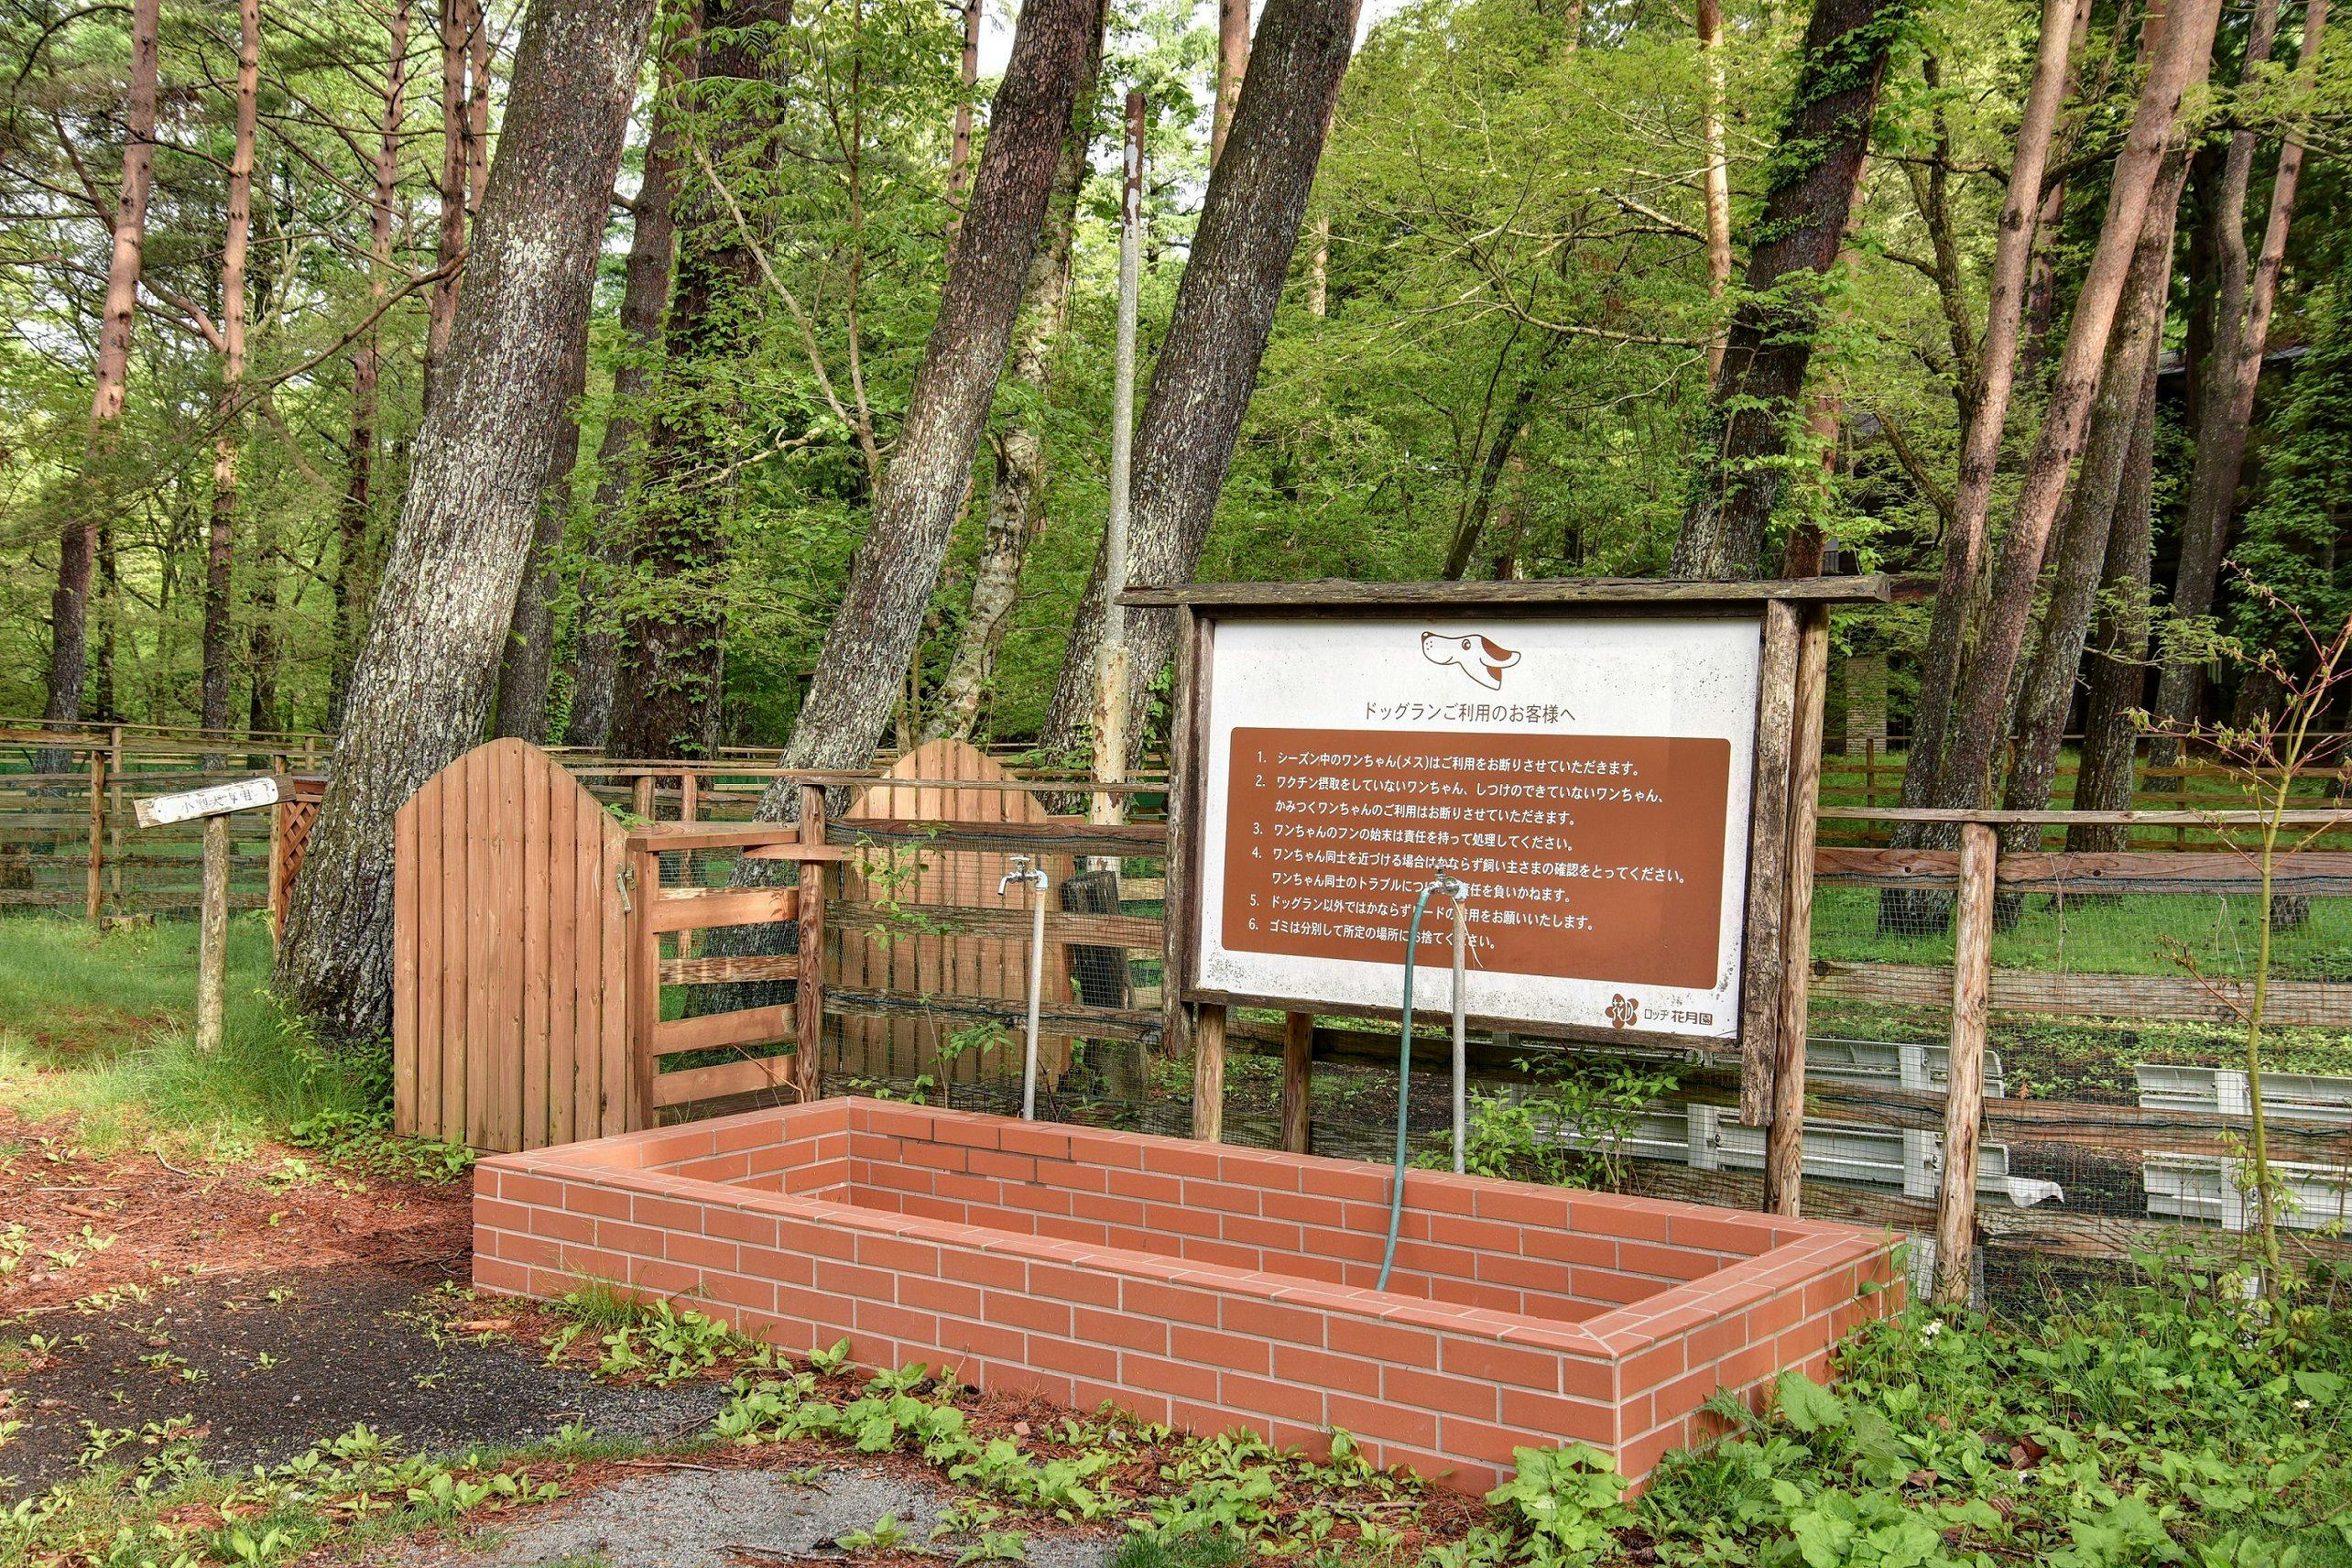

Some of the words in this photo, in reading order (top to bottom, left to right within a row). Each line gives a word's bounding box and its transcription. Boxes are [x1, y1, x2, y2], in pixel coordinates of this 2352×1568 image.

[1366, 701, 1576, 724] ドッグランご利用のお客様へ
[1257, 750, 1267, 763] 1.
[1277, 751, 1639, 777] シーズン中のワンちゃん(メス)はご利用をお断りさせていただきます。
[1255, 774, 1266, 788] 2.
[1274, 800, 1575, 826] かみつくワンちゃんのご利用はお断りさせていただきます。
[1252, 822, 1263, 835] 3.
[1273, 823, 1573, 852] ワンちゃんのフンの始末は責任を持って処理してください。
[1251, 845, 1262, 859] 4.
[1249, 893, 1259, 907] 5.
[1271, 894, 1594, 931] ドッグラン以外ではかならずードの用をお願いいたします。
[1248, 917, 1258, 931] 6.
[1269, 918, 1496, 951] ゴミは分別して所定の場所に捨てくさい。
